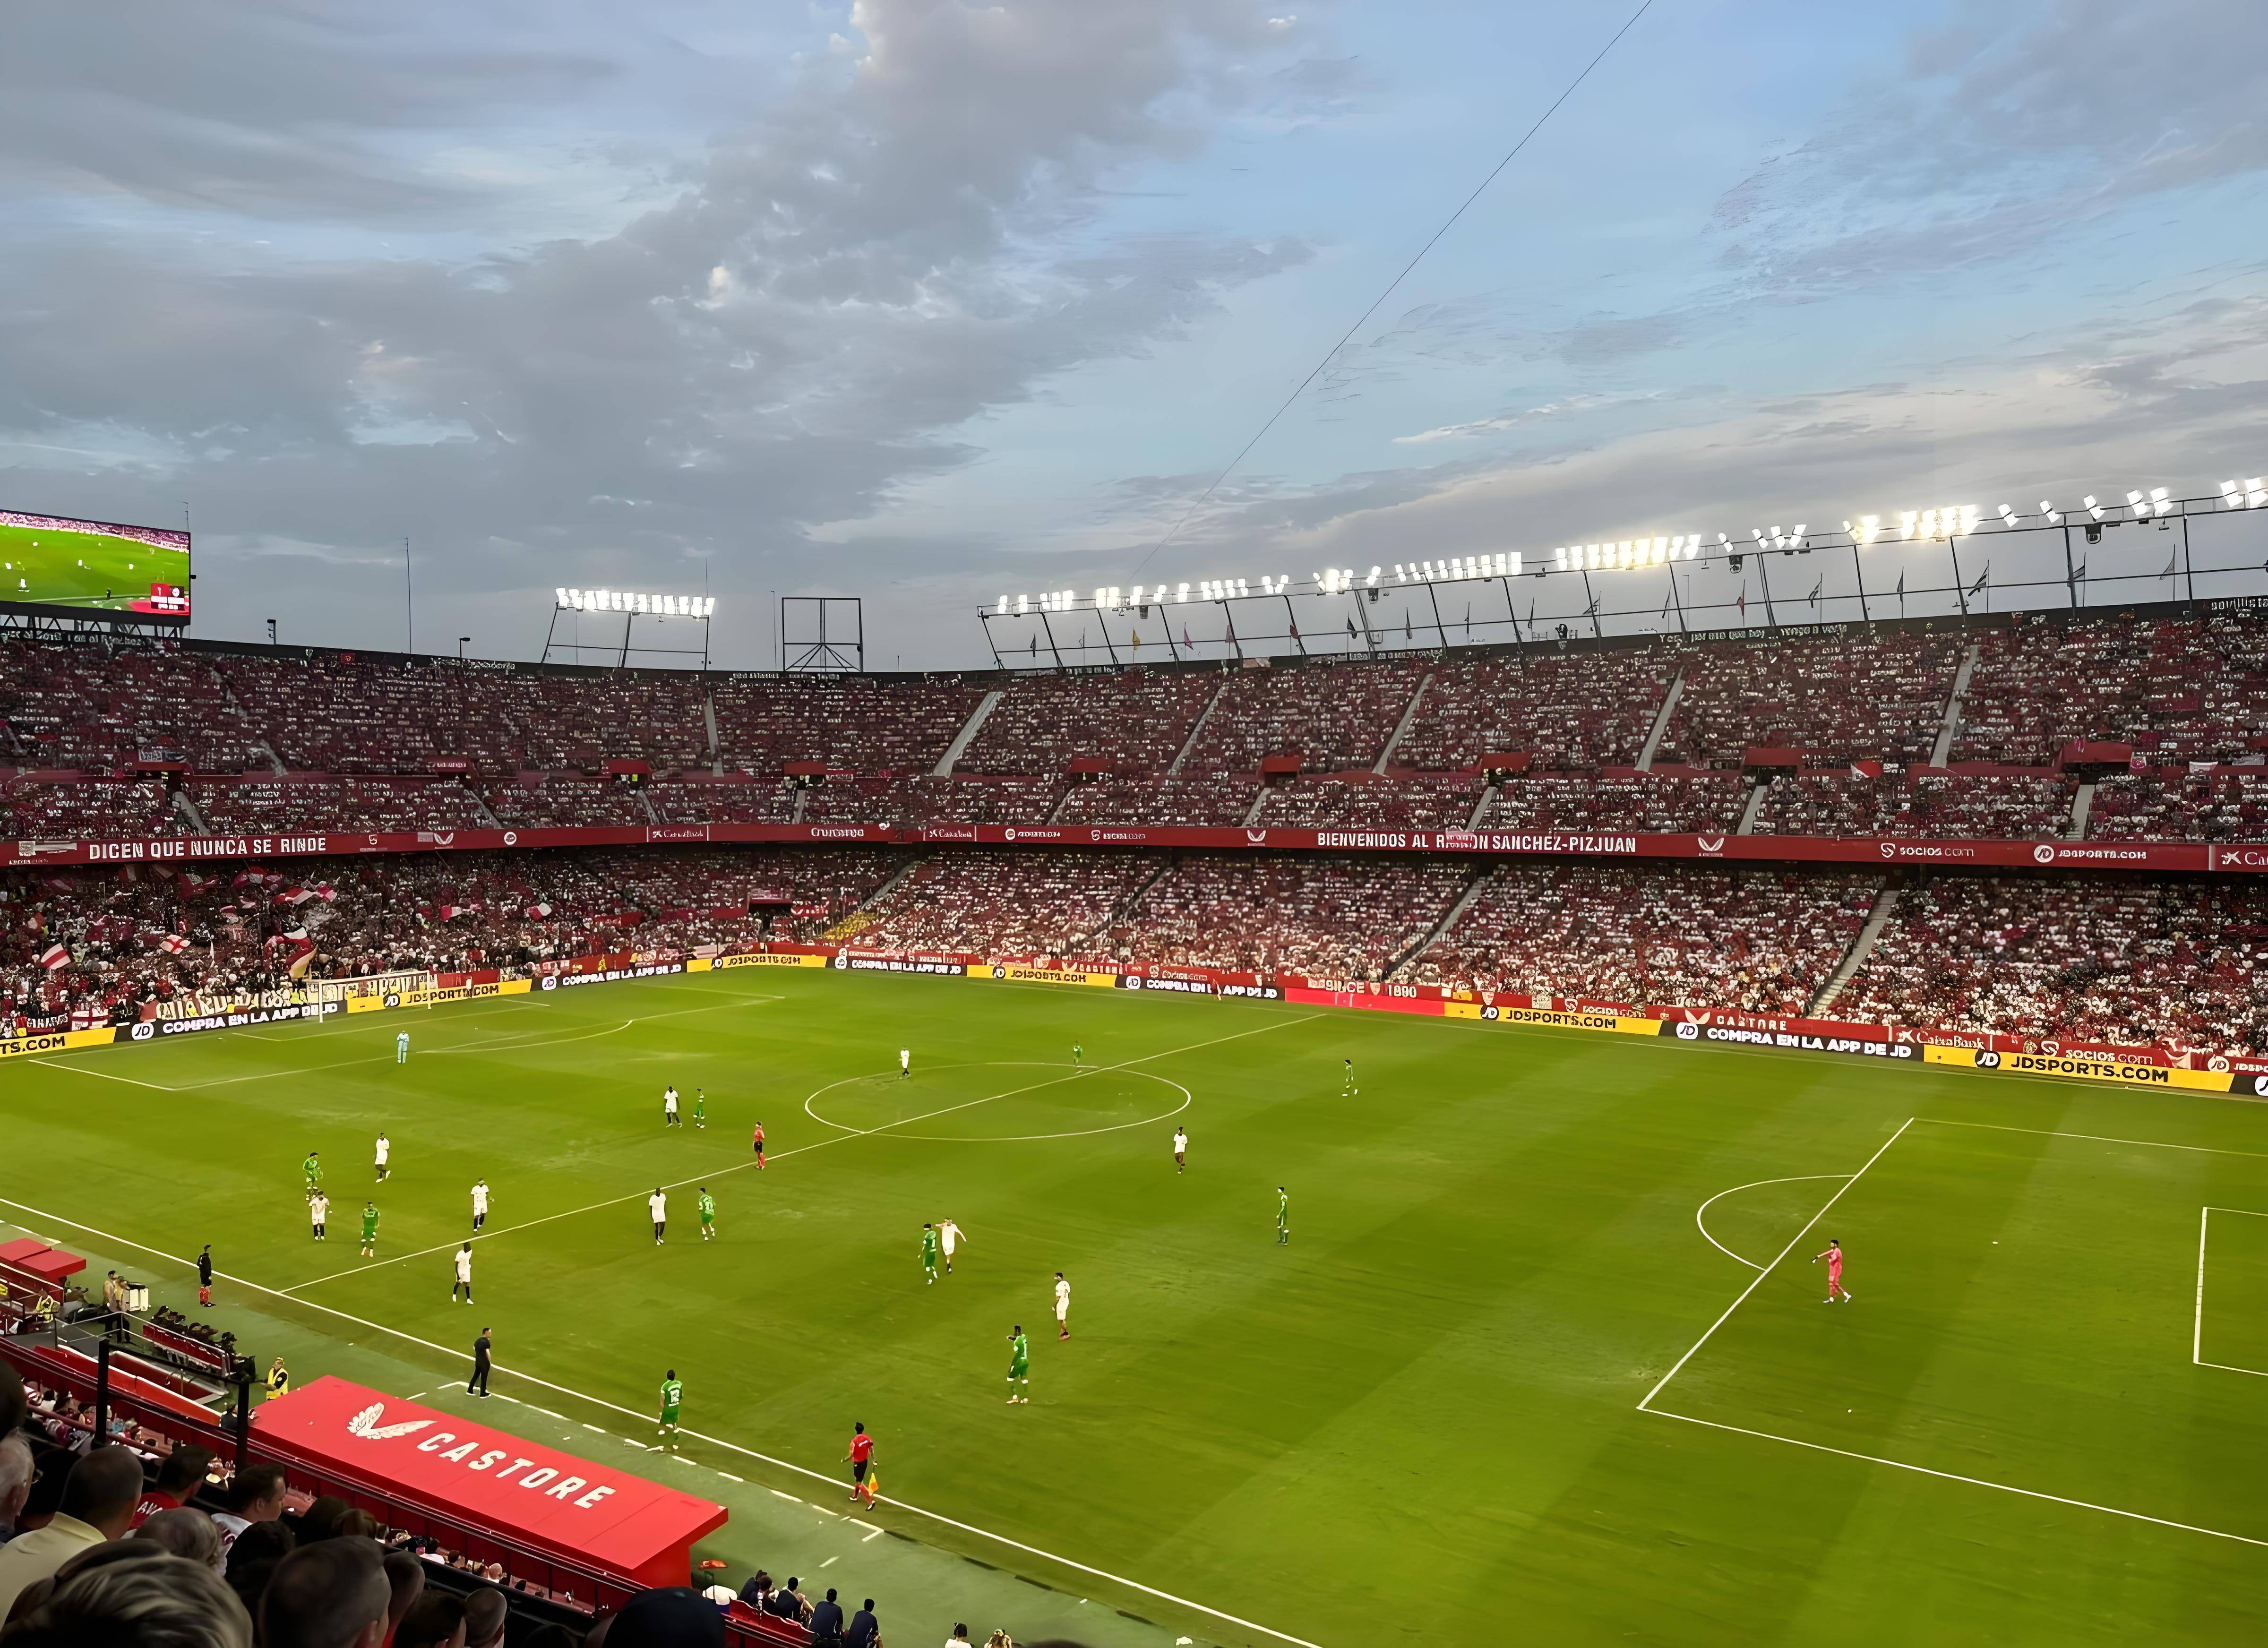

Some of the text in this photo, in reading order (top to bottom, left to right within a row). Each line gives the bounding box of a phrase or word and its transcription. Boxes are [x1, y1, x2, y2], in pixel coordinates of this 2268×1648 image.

[90, 837, 326, 859] DICEN QUE NUNCA SE RINDE
[1318, 833, 1406, 847] BIENVENIDOS
[1412, 834, 1429, 848] AL
[163, 1016, 225, 1034] COMPRA
[1506, 1010, 1616, 1029] JDSPORTS.COM
[1707, 1028, 1911, 1058] COMPRA EN LA APP DE JD
[2011, 1056, 2168, 1082] JDSPORTS.COM
[417, 1433, 616, 1509] CASTORE
